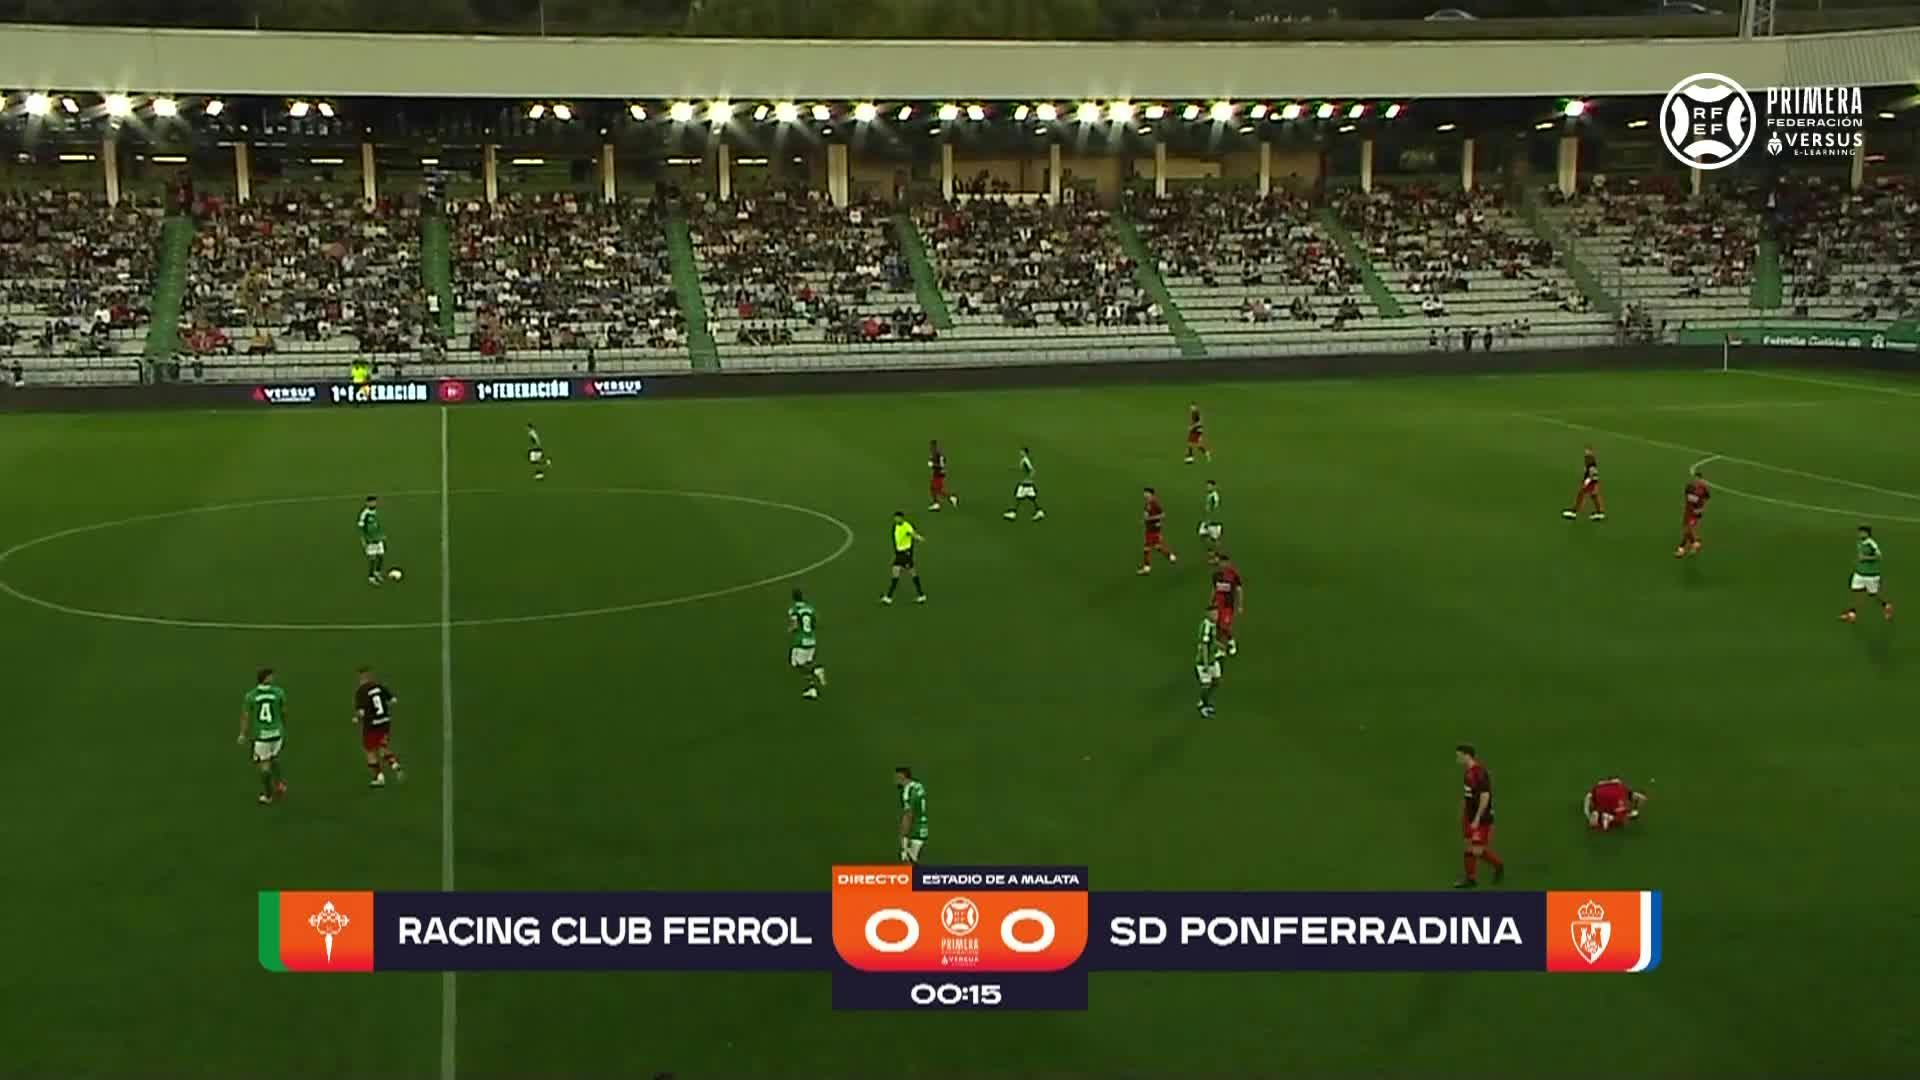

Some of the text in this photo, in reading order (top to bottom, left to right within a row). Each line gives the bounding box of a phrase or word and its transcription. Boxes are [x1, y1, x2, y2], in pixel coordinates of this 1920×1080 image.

[264, 387, 316, 398] VERSUS
[348, 382, 428, 401] FERACIÓN
[492, 380, 569, 399] FEDERACIÓN
[594, 380, 642, 392] VERSUS
[259, 703, 272, 722] 4
[372, 695, 384, 715] 9
